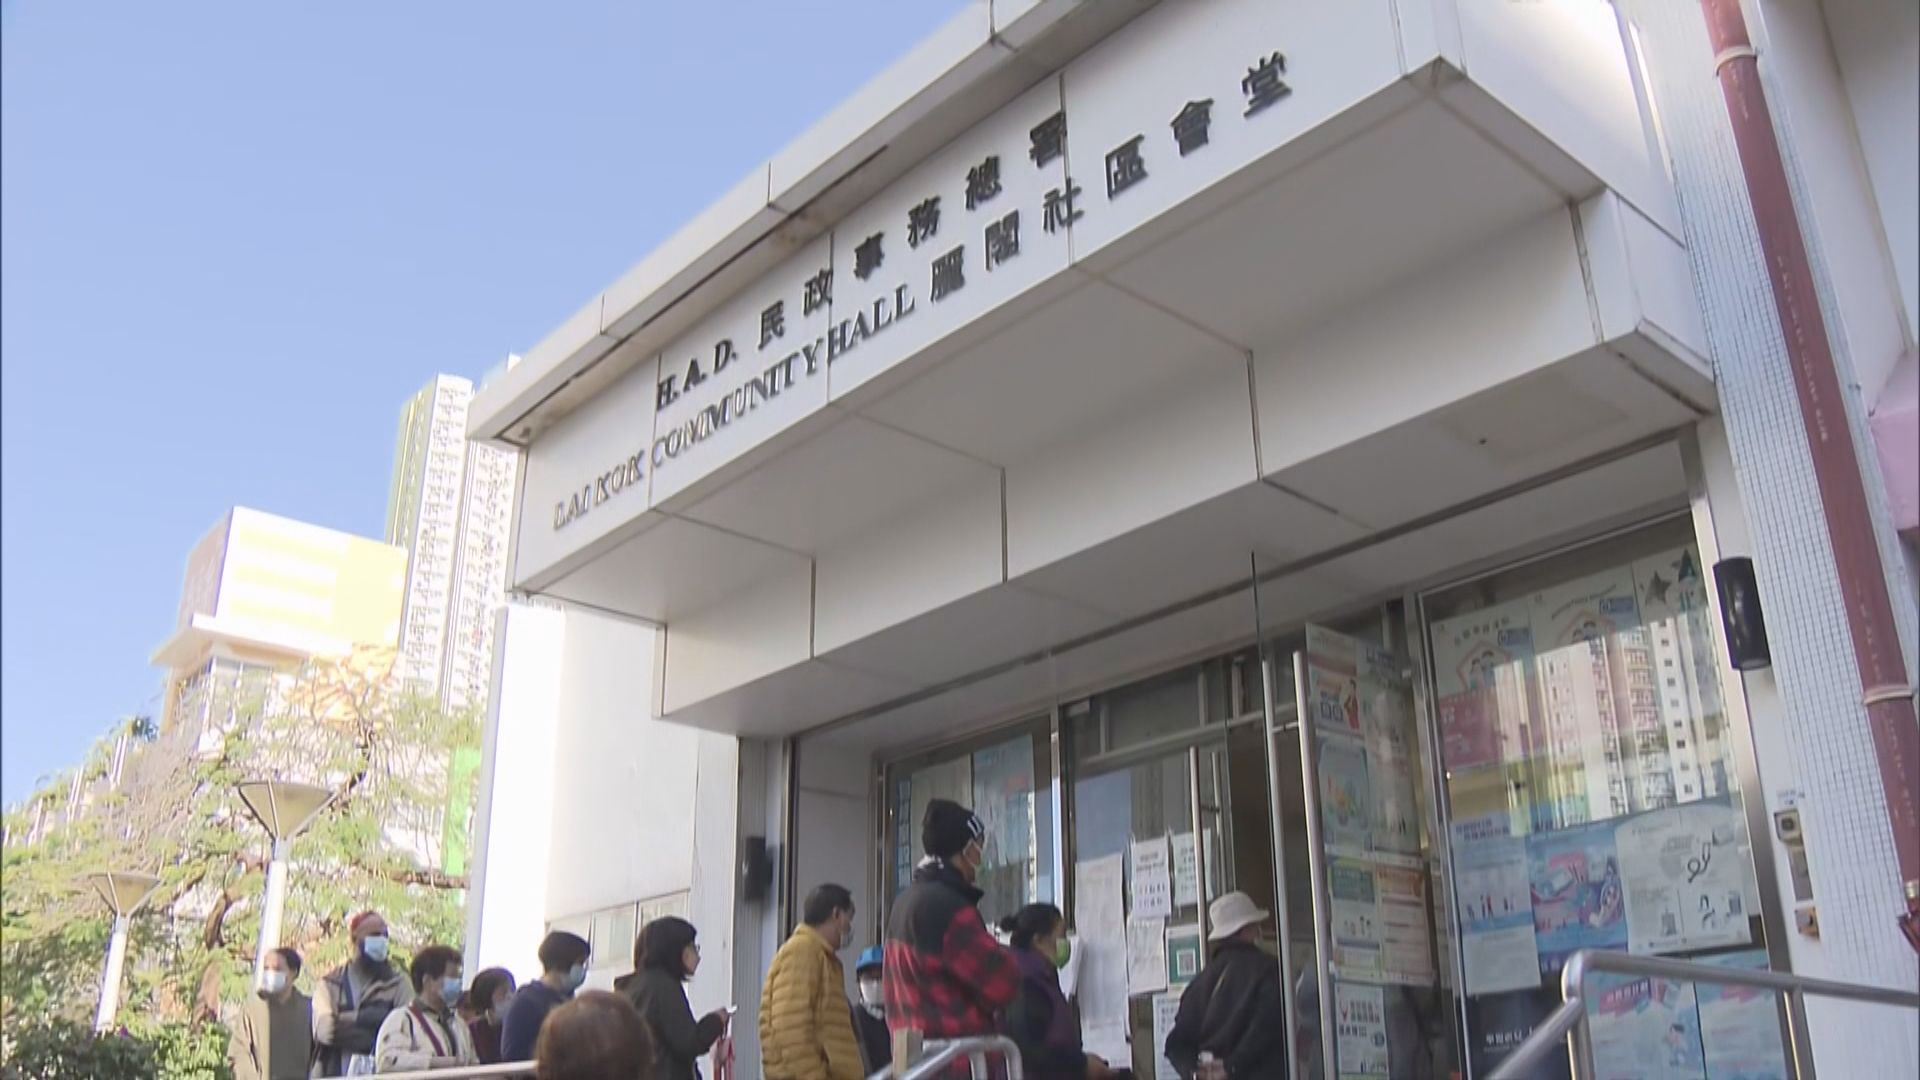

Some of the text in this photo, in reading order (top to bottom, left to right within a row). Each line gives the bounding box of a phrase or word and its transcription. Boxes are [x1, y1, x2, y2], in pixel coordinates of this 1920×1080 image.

[553, 50, 1292, 530] LAI KOK COMMUNITY HALL 麗閣社區會堂
[758, 110, 1067, 349] 民政事務總署
